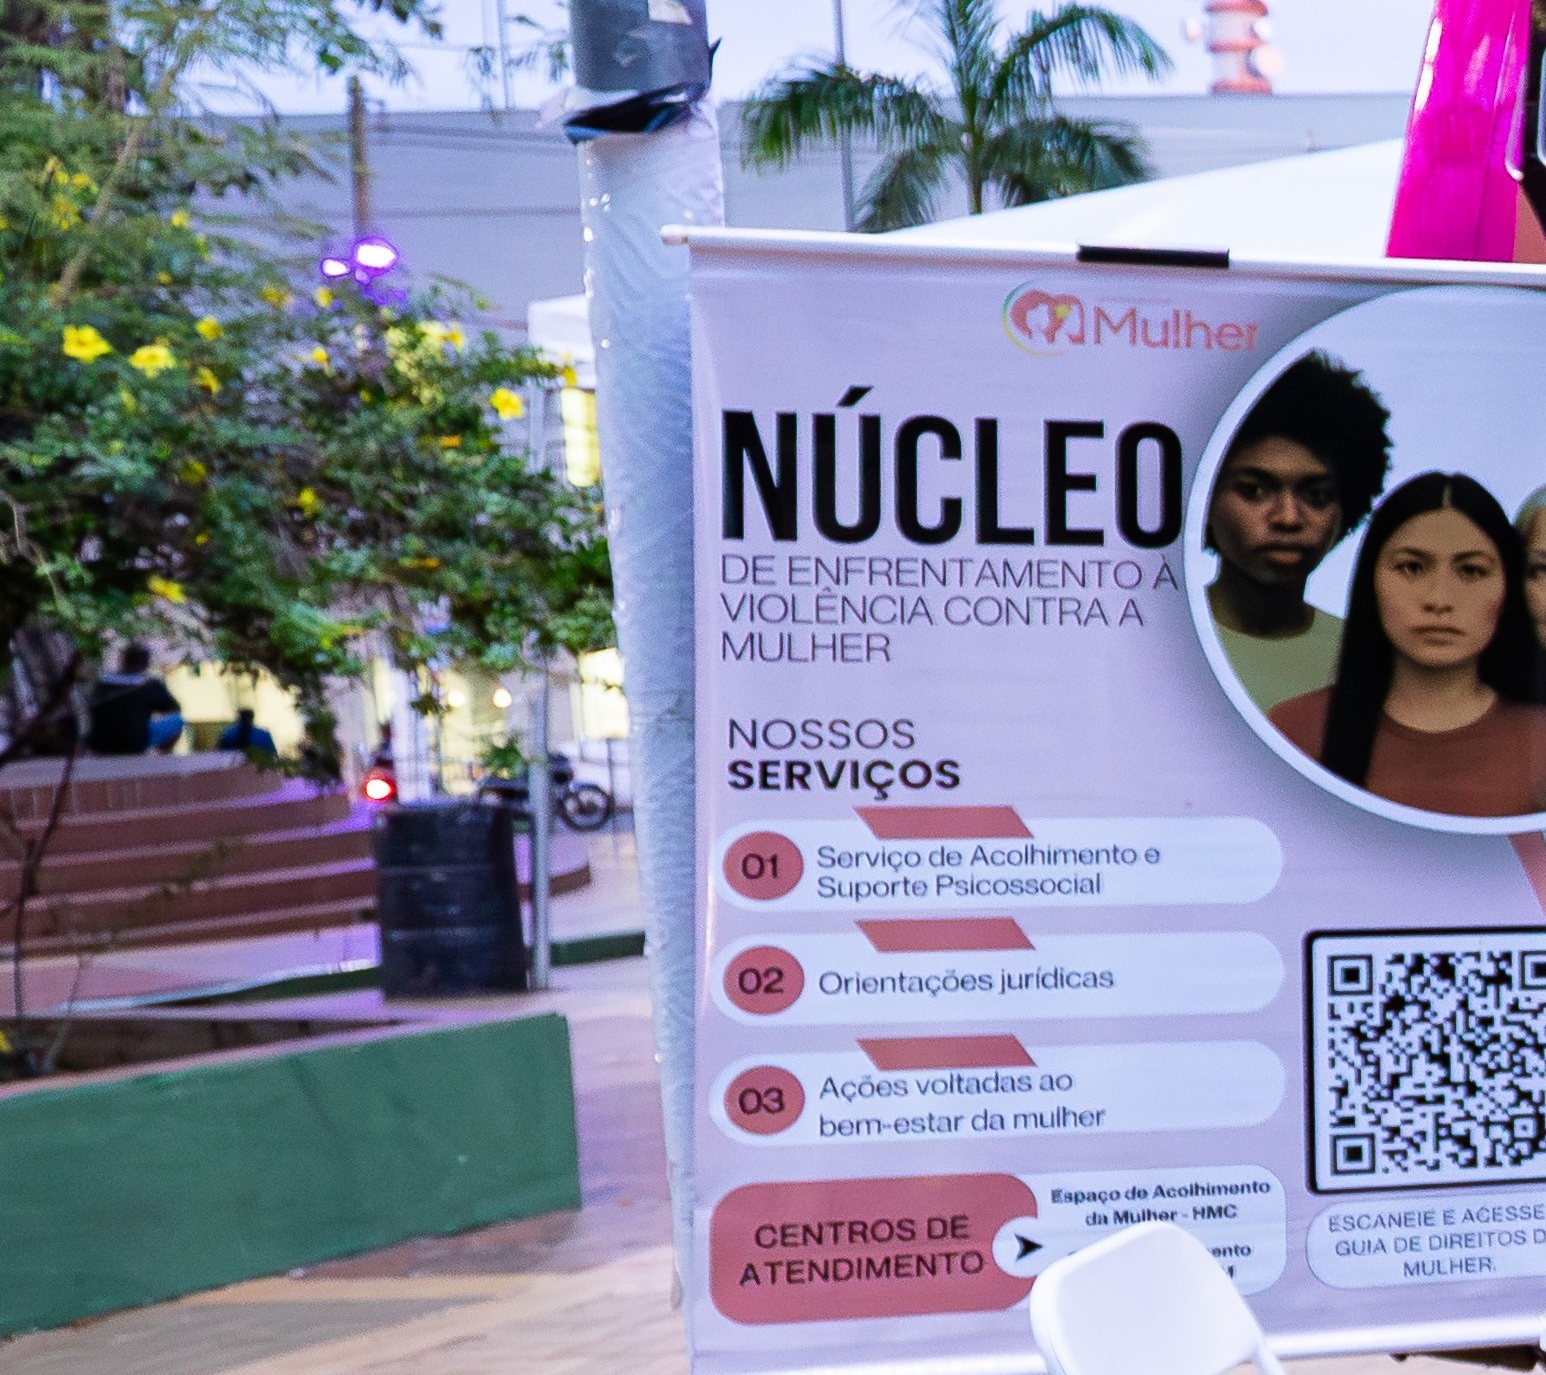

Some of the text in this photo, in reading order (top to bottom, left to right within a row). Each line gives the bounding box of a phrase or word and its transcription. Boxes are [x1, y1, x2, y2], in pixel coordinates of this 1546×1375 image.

[1094, 306, 1258, 352] Mulher
[721, 385, 1183, 548] NÚCLEO
[721, 554, 1179, 590] DE ENFRENTAMENTO À
[720, 587, 1144, 626] VIOLÊNCIA CONTRA A
[722, 632, 890, 662] MULHER
[729, 718, 916, 750] NOSSOS
[729, 759, 960, 800] SERVIÇOS
[742, 844, 1160, 880] 01 Serviço de Acolhimento e
[818, 873, 1101, 901] Suporte Psicossocial
[739, 965, 1114, 998] 02 Orientações jurídicas
[739, 1072, 1072, 1114] 03 Ações voltadas ao
[819, 1106, 1105, 1137] bem-estar da mulher
[1051, 1180, 1271, 1205] Espaço de Acolhimento
[755, 1214, 969, 1249] CENTROS DE
[1085, 1211, 1108, 1226] da
[1113, 1208, 1177, 1226] Mulher
[1193, 1204, 1237, 1221] HMC
[1329, 1209, 1435, 1233] ESCANEIE
[1443, 1208, 1455, 1225] E
[1462, 1203, 1545, 1224] ACESSE
[1335, 1238, 1387, 1257] GUIA
[1394, 1235, 1421, 1252] DE
[1429, 1229, 1527, 1251] DIREITOS
[739, 1250, 983, 1287] ATENDIMENTO
